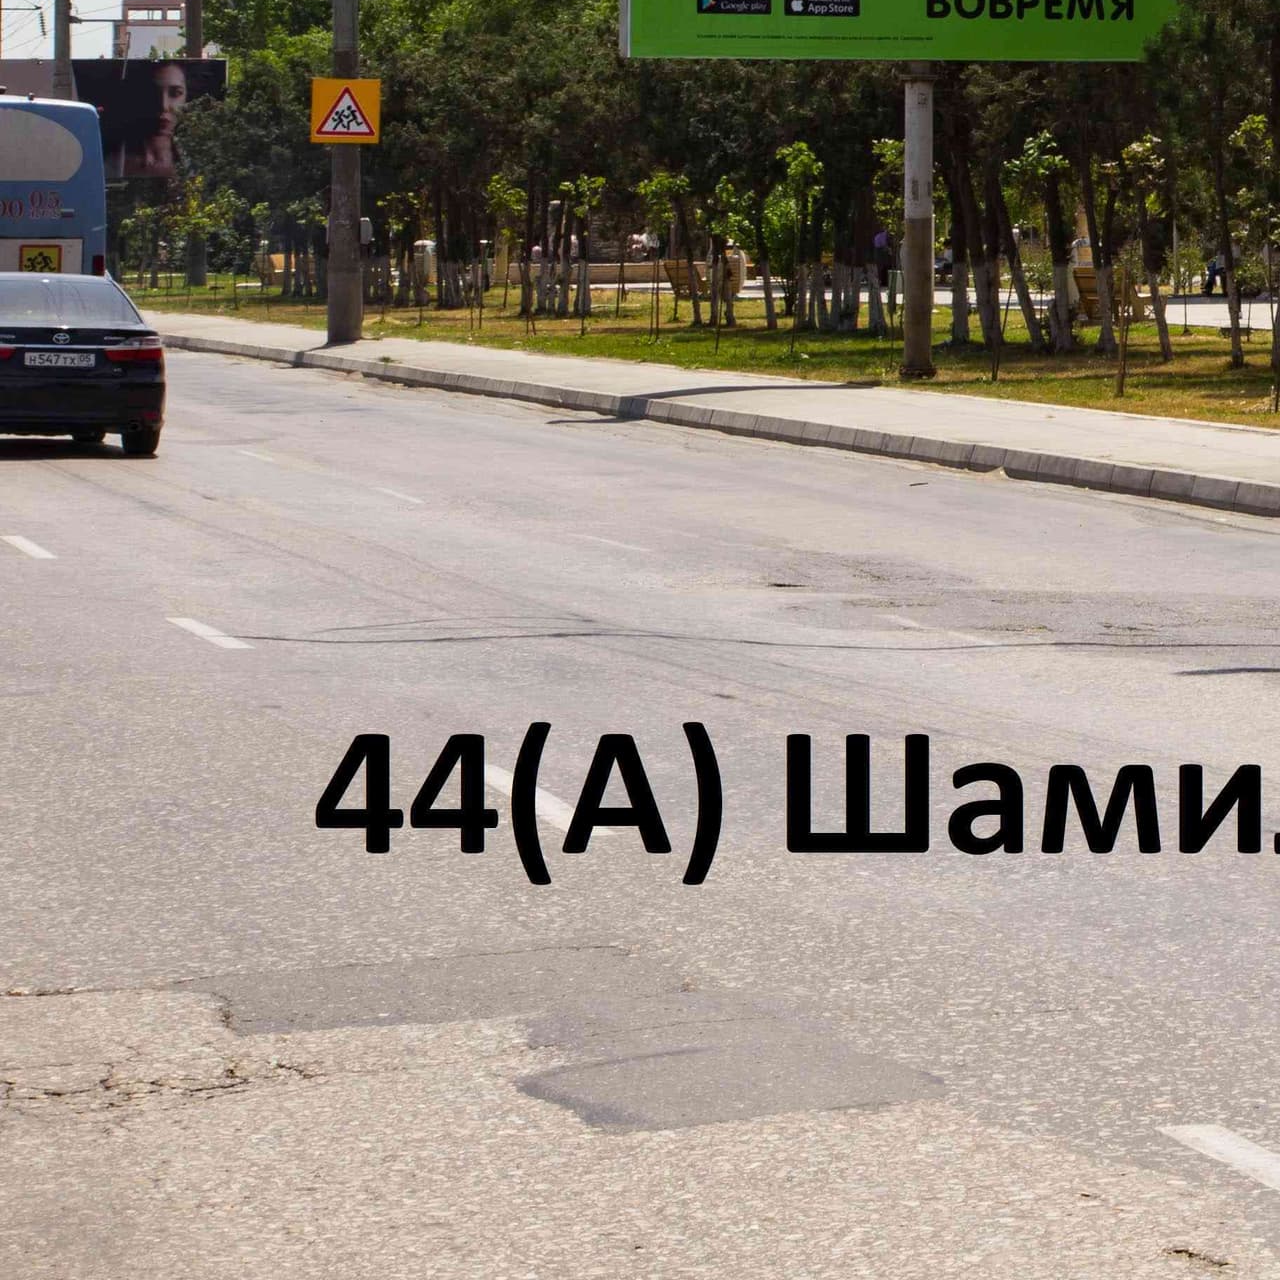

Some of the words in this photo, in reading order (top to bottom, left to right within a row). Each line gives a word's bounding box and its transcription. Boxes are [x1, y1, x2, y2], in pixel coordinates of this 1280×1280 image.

[720, 0, 750, 13] Google
[807, 2, 828, 14] App
[828, 2, 854, 13] Store
